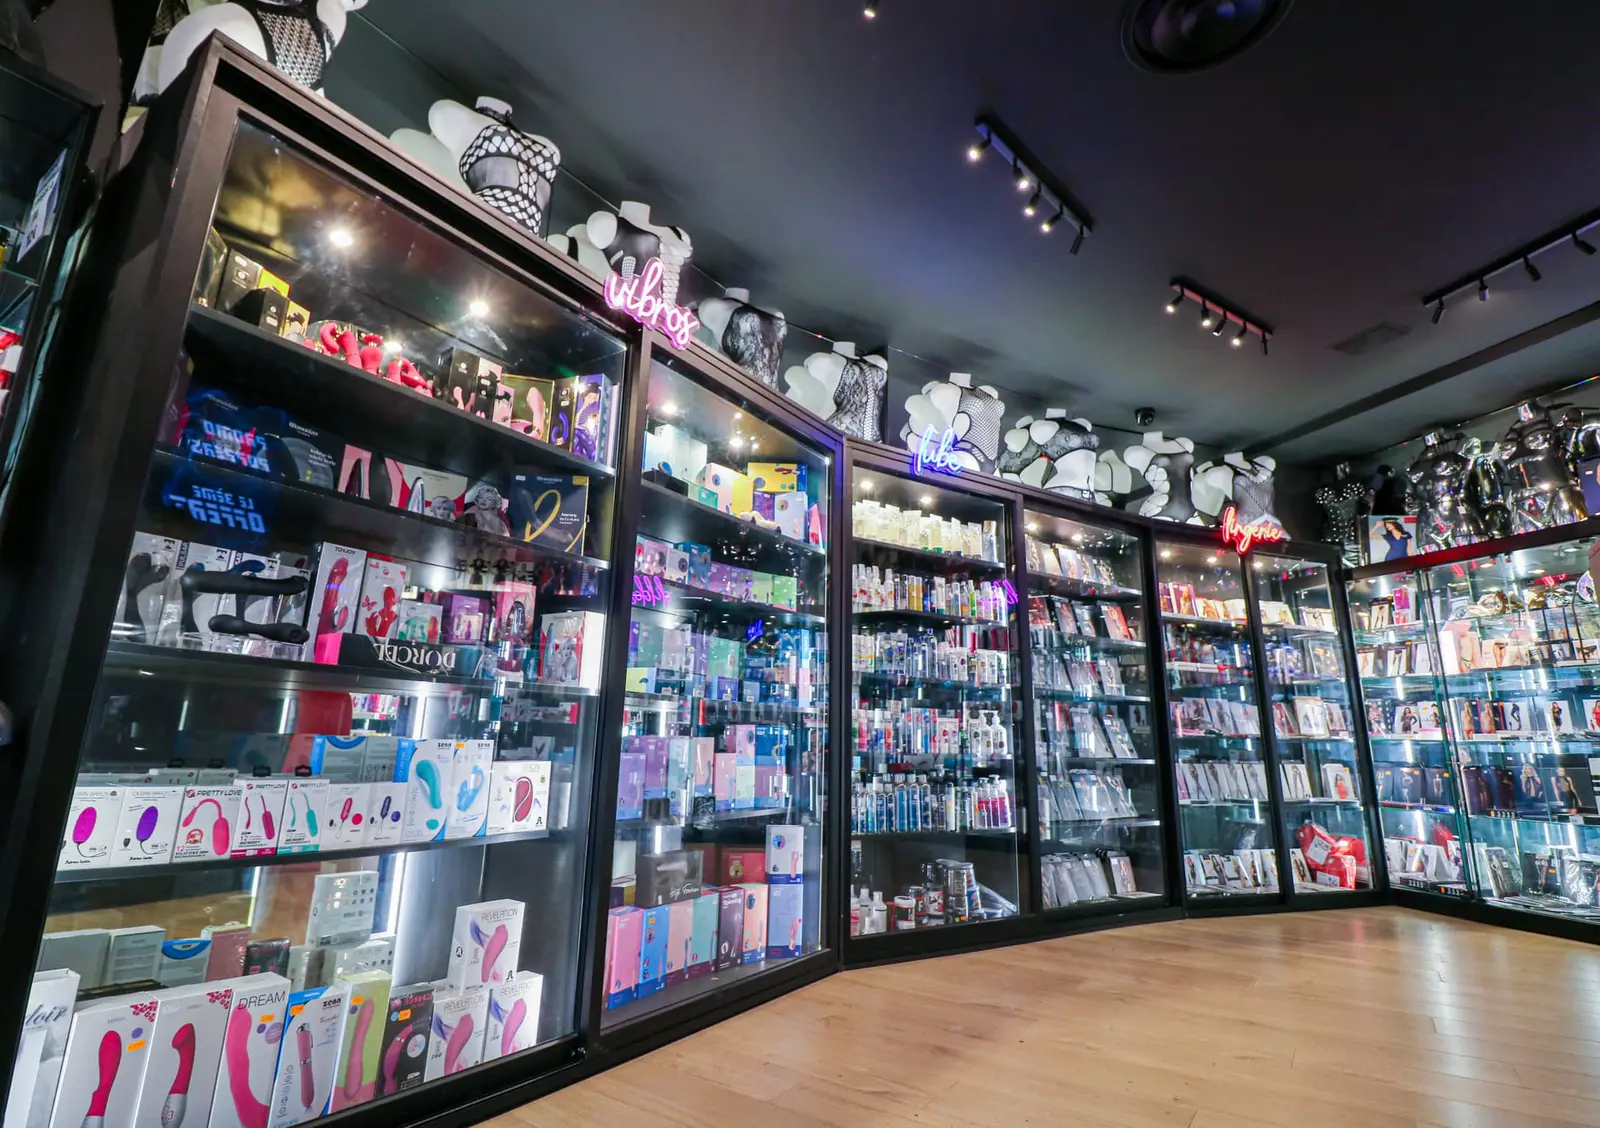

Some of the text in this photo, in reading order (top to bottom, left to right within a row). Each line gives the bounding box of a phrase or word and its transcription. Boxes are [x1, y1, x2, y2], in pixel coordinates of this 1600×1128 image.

[373, 643, 456, 669] DORCEL
[196, 789, 225, 797] PRETTY
[480, 907, 519, 921] REVELATION
[238, 990, 286, 1011] DREAM
